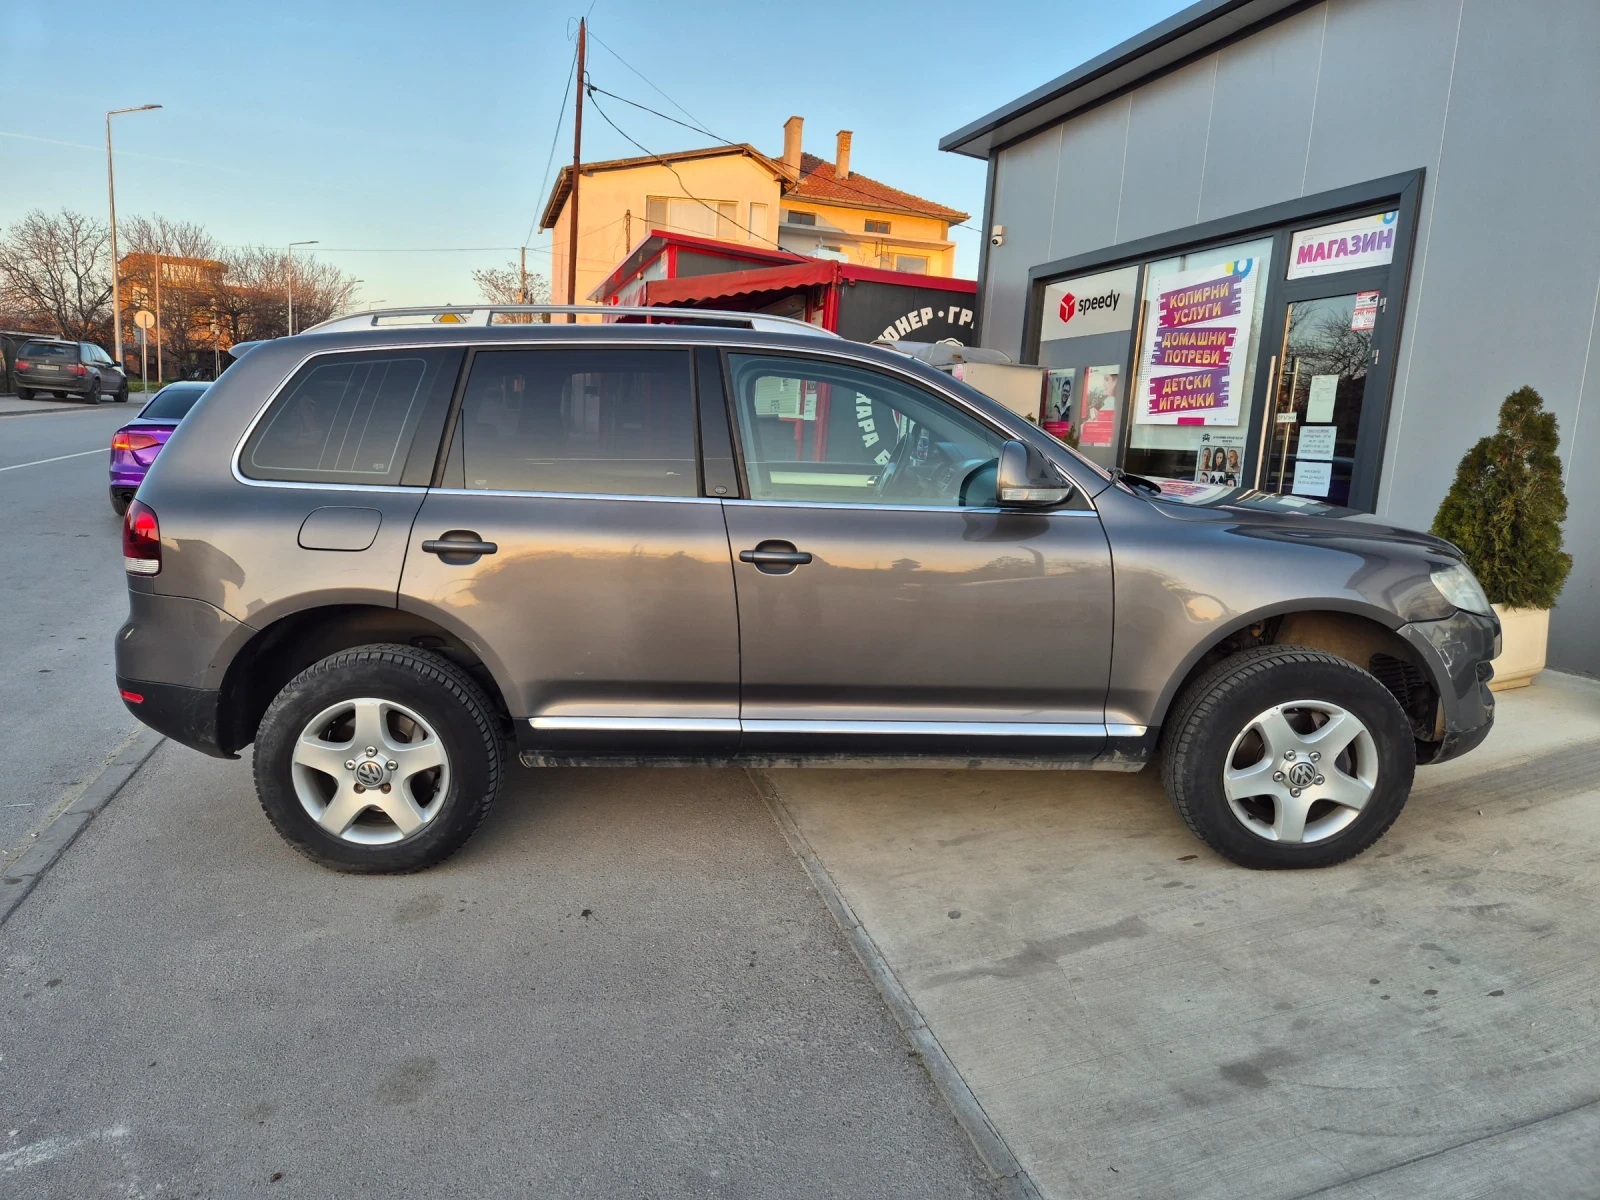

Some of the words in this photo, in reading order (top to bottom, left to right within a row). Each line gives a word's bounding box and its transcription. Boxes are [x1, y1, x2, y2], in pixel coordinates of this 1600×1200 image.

[1296, 228, 1394, 265] МАГАЗИН
[1078, 289, 1120, 316] speedy
[1169, 282, 1230, 309] КОПИРНИ
[877, 306, 934, 341] ЮНЕР
[947, 305, 974, 330] ГР
[1173, 301, 1222, 325] УСЛУГИ
[1161, 331, 1227, 349] ДОМАШНИ
[1164, 349, 1221, 365] ПОТРЕБИ
[1162, 373, 1212, 395] ДЕТСКИ
[1158, 392, 1215, 411] ИГРАЧКИ
